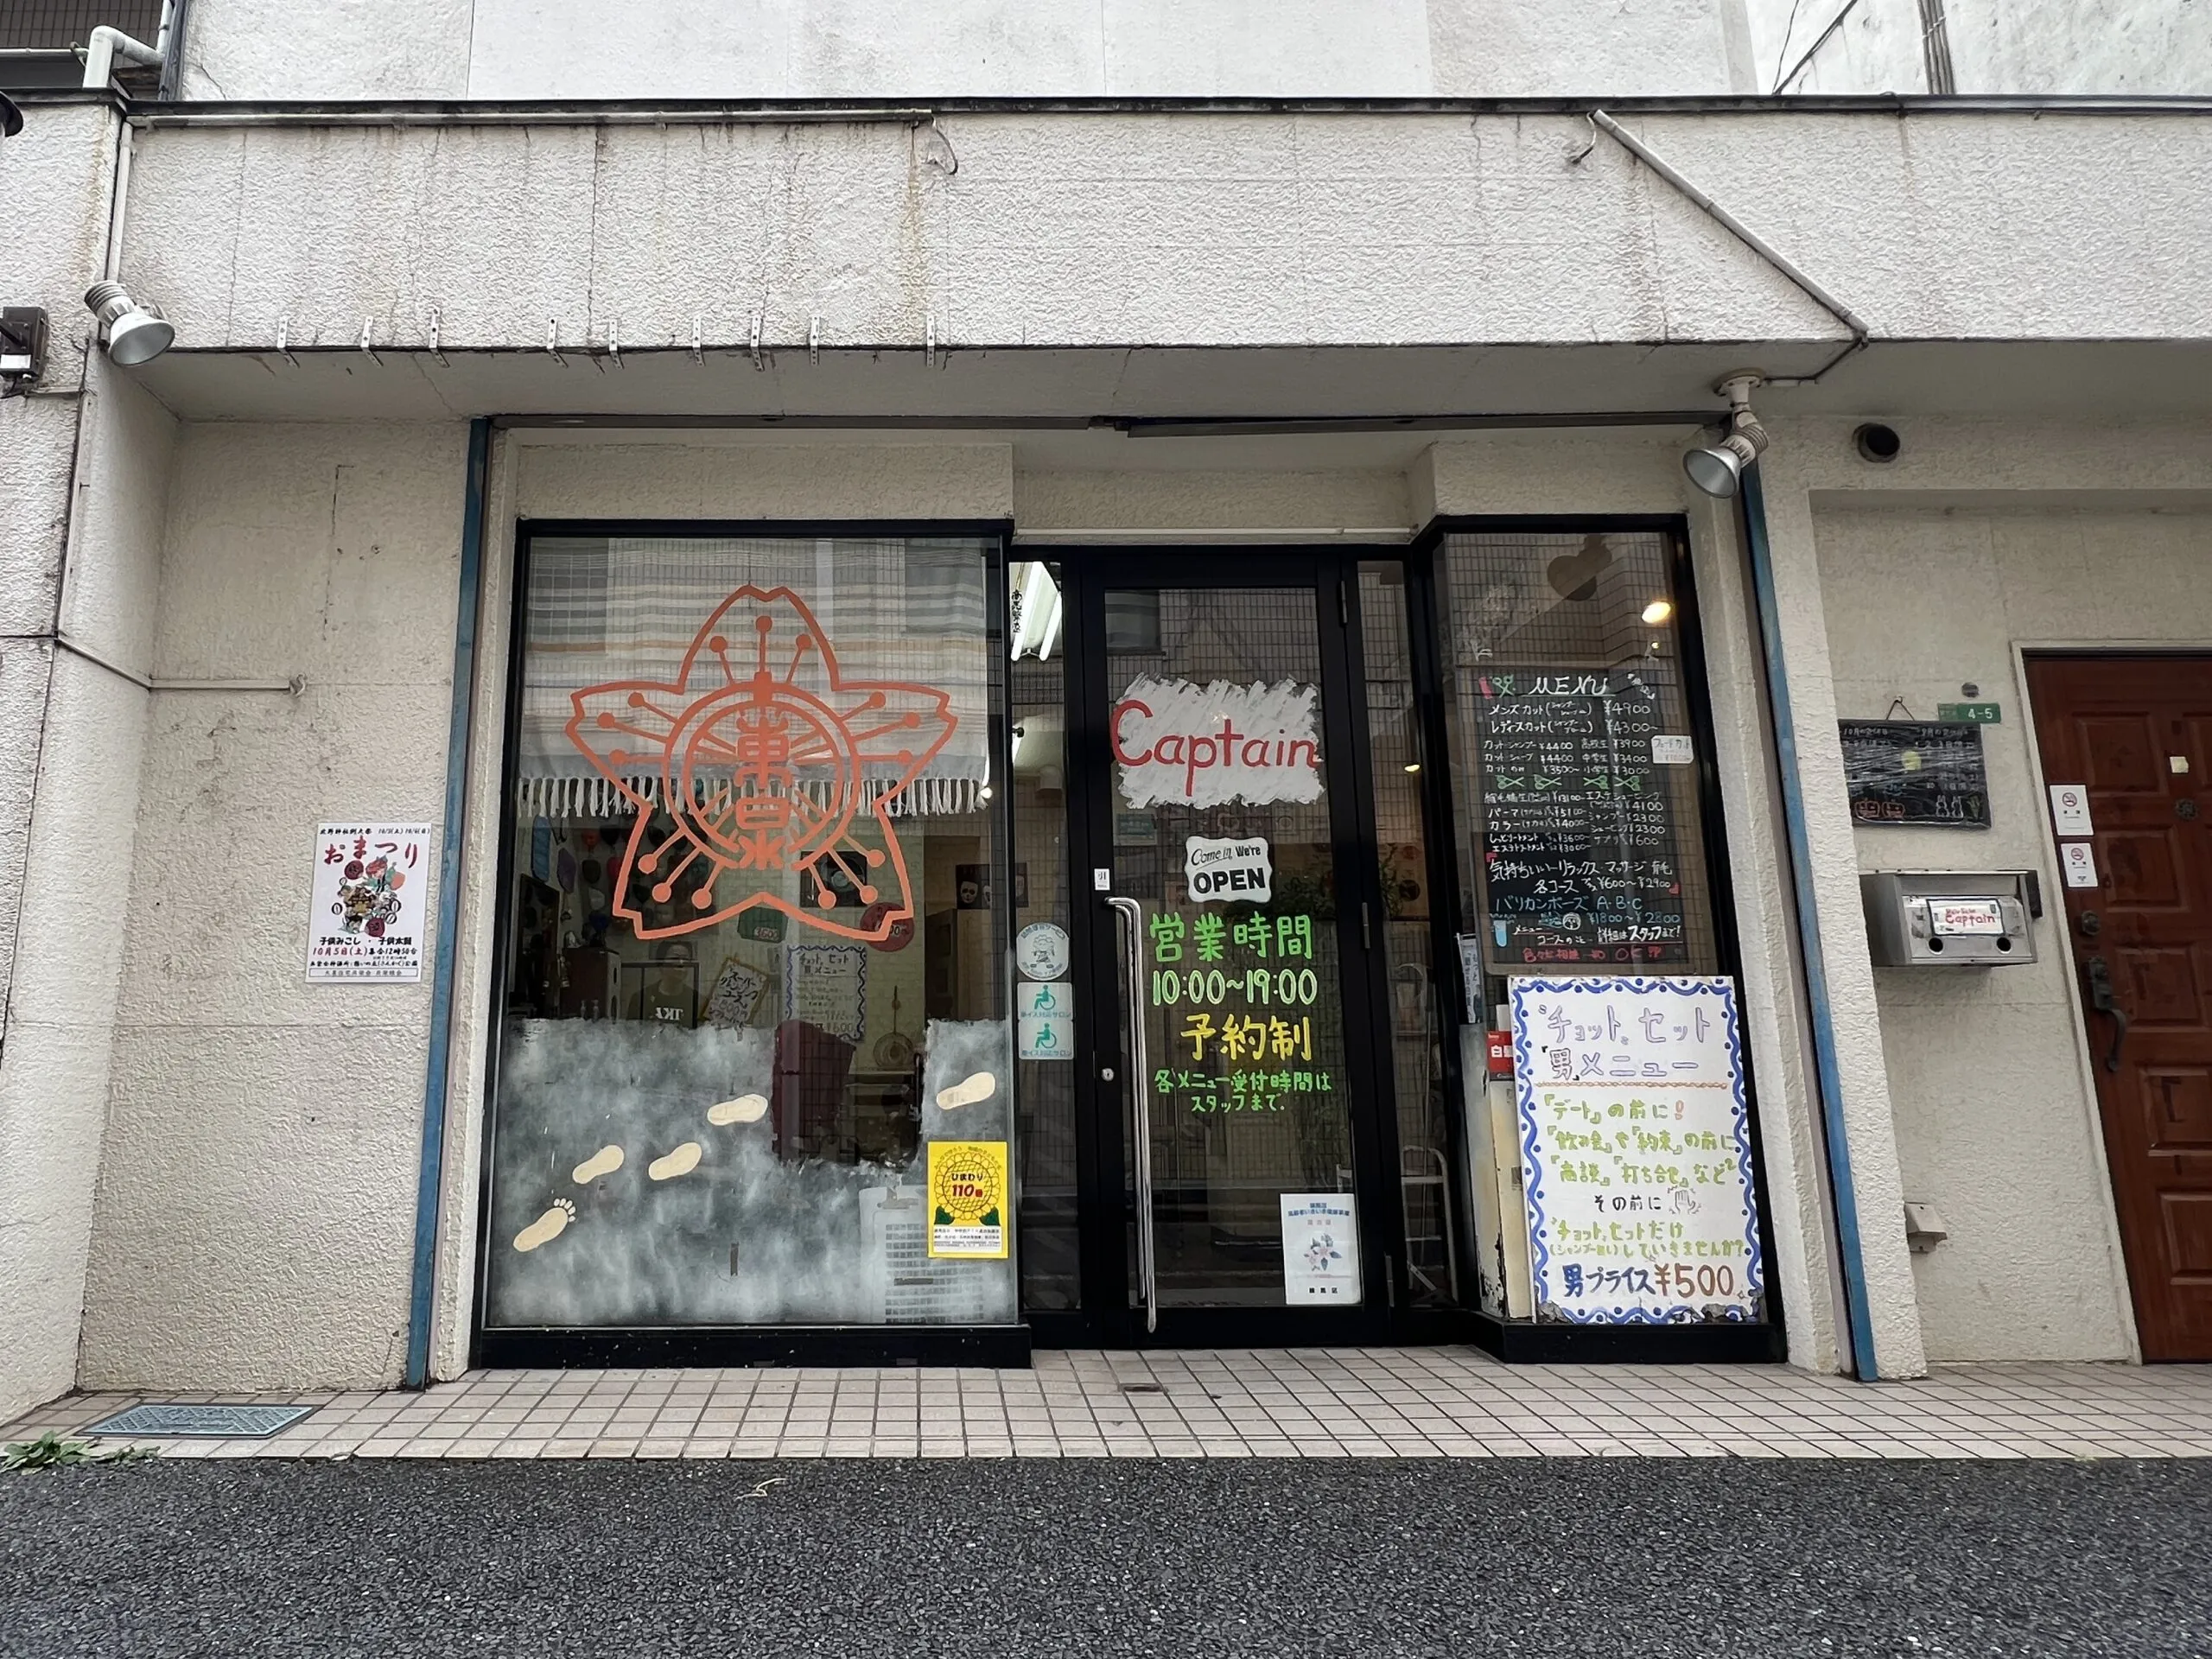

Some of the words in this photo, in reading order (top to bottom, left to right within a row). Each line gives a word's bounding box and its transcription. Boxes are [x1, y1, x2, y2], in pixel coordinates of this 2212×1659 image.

[1529, 675, 1609, 696] MENU
[1603, 699, 1651, 715] ¥4900
[1968, 708, 1993, 719] 4-5
[1110, 699, 1323, 797] Captain
[1612, 738, 1646, 750] ¥3900
[1613, 753, 1648, 764] ¥3400
[1612, 765, 1649, 775] ¥3000
[1488, 808, 1519, 817] パーマ
[1626, 812, 1665, 823] ¥2300
[1490, 821, 1521, 830] カラー
[1630, 823, 1666, 834] ¥2300
[1630, 834, 1659, 846] ¥600
[324, 835, 418, 868] おまつり
[1191, 849, 1221, 866] Come
[1236, 844, 1261, 857] We're
[1193, 868, 1266, 894] OPEN
[1945, 914, 1996, 927] Captain
[1149, 911, 1313, 963] 営業時間
[1638, 1007, 1710, 1043] セット
[1180, 1013, 1312, 1063] 予約制
[1154, 1068, 1332, 1094] 各メニュー受付時間は
[951, 1173, 983, 1181] ひまわり
[1594, 1194, 1662, 1213] その前に
